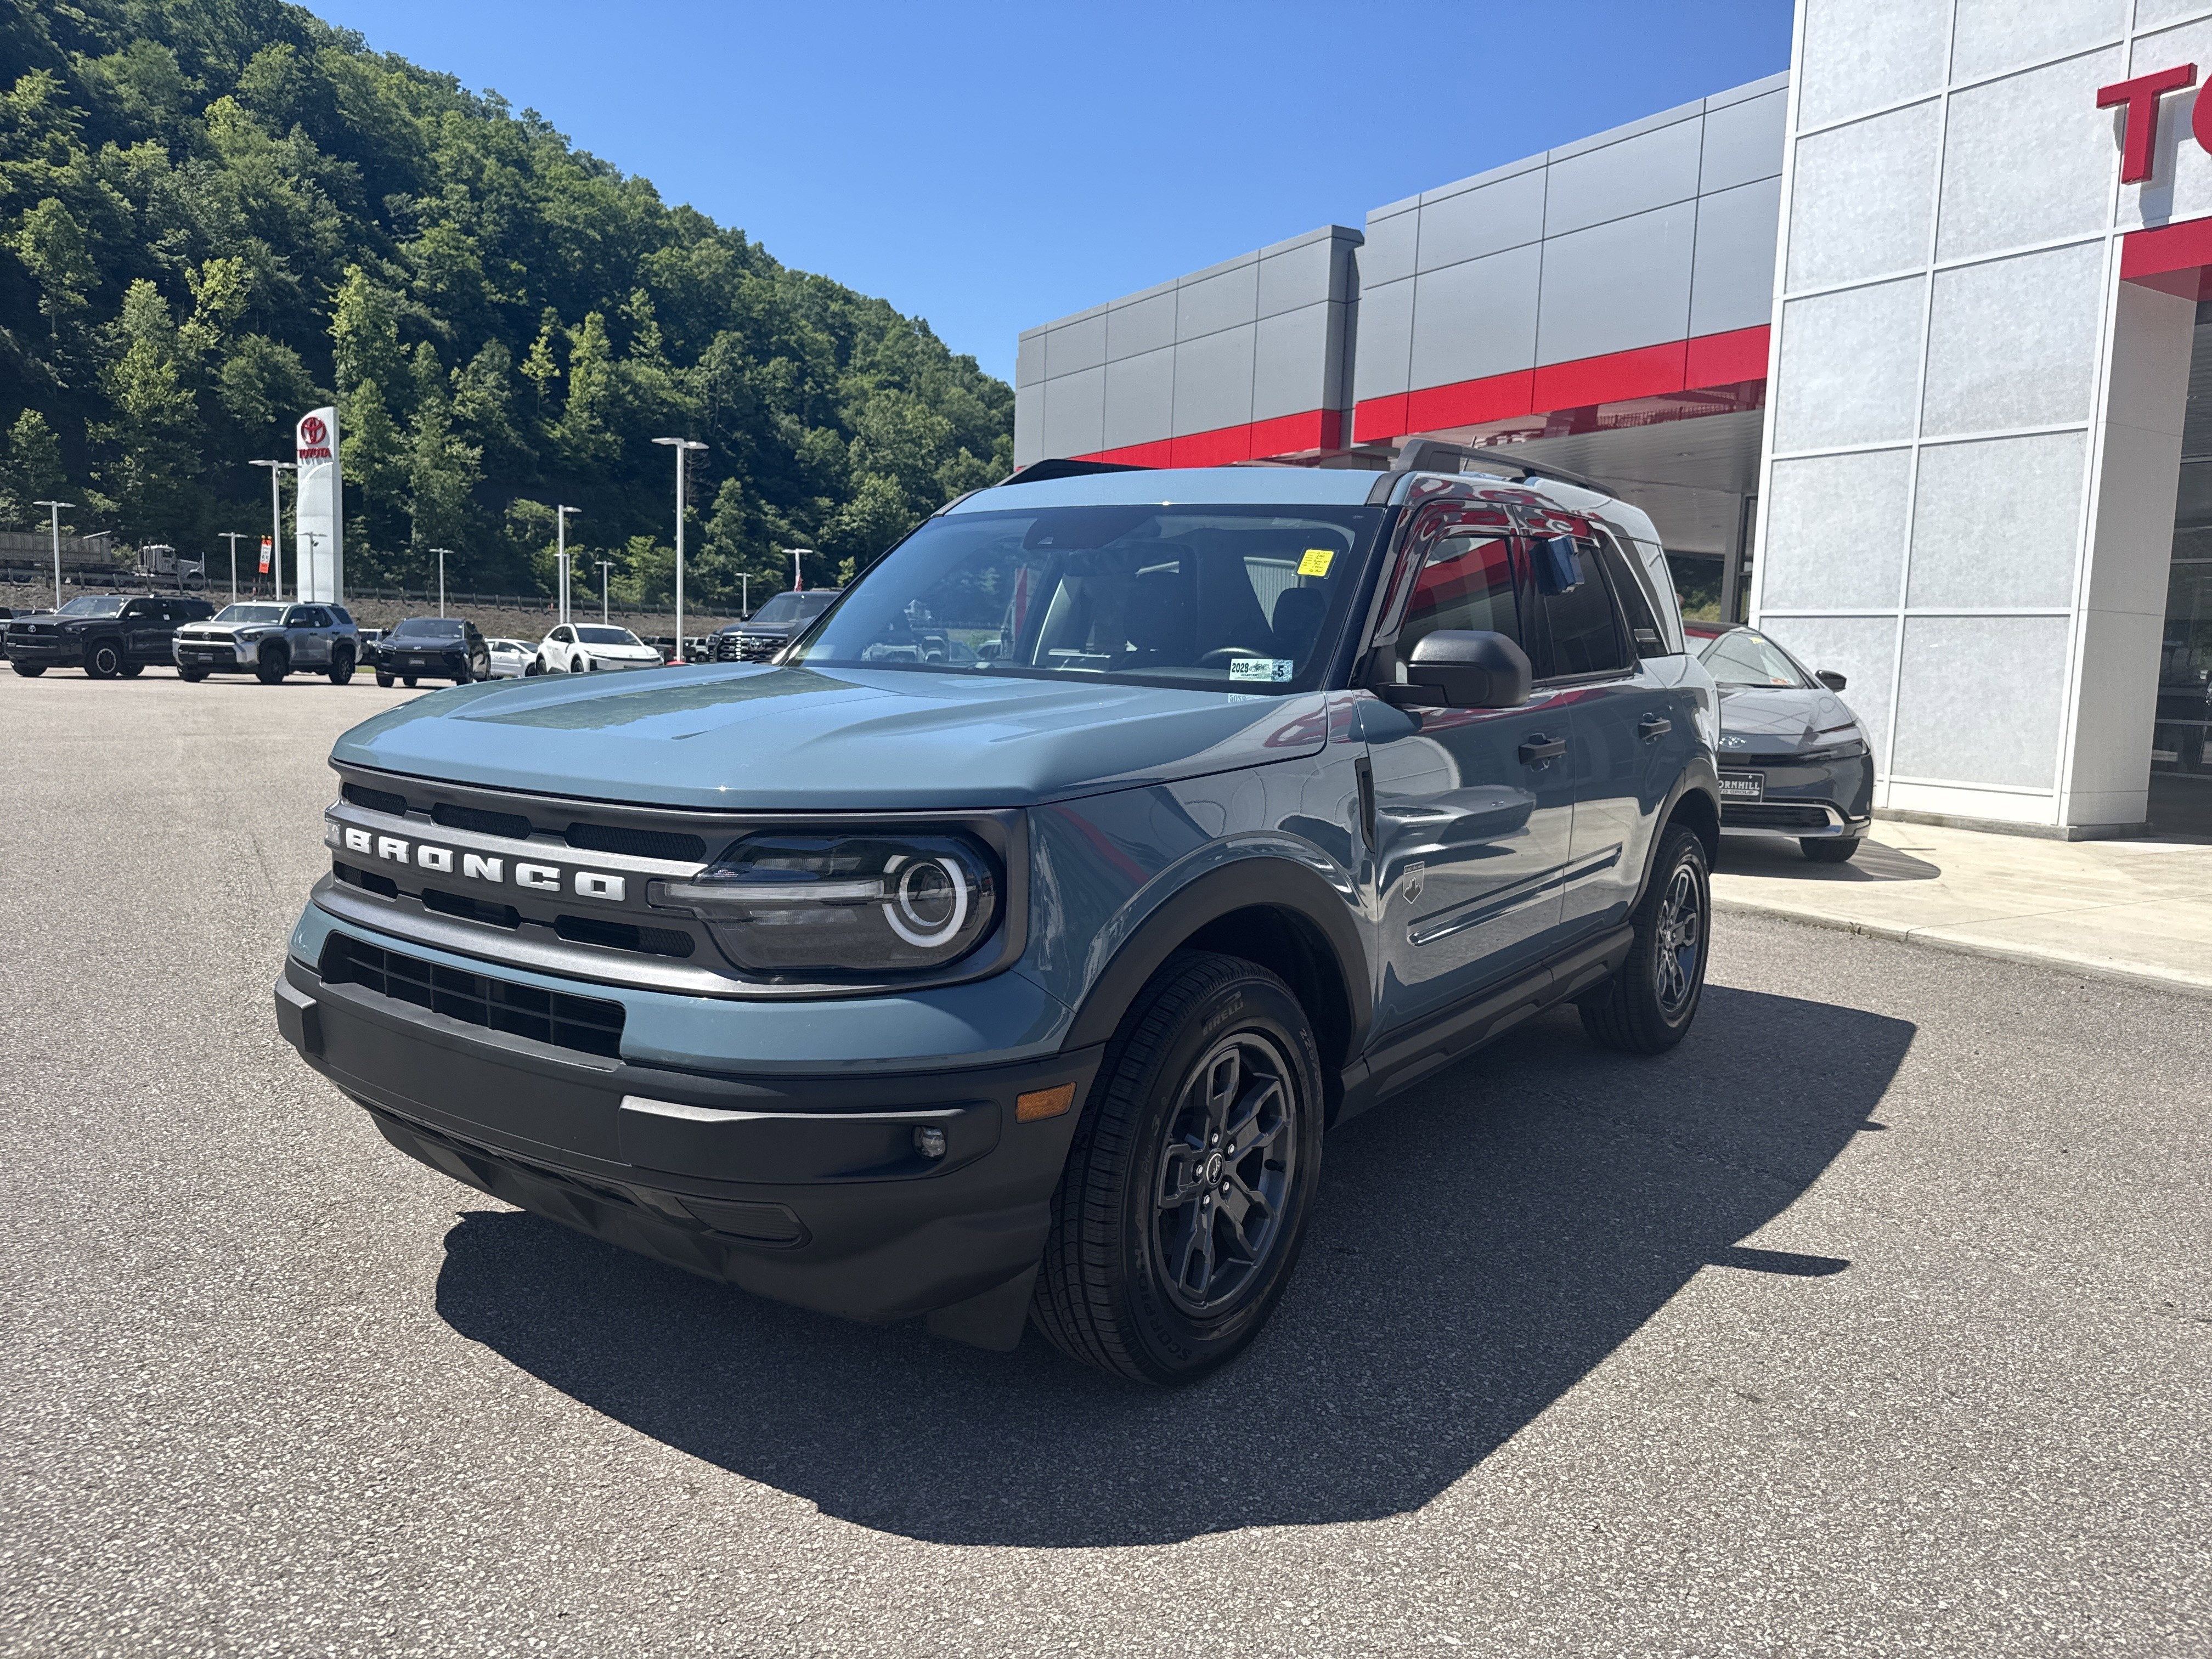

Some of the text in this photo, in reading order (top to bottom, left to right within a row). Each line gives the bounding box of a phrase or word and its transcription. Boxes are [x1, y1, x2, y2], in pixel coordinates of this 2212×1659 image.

[2096, 63, 2212, 185] T
[298, 448, 332, 459] TOYOTA
[1231, 662, 1284, 677] 2028 5
[345, 827, 625, 901] BRONCO
[1202, 991, 1244, 1036] PIRELLI
[1152, 1114, 1161, 1137] 3
[1135, 1248, 1193, 1362] SCORPION
